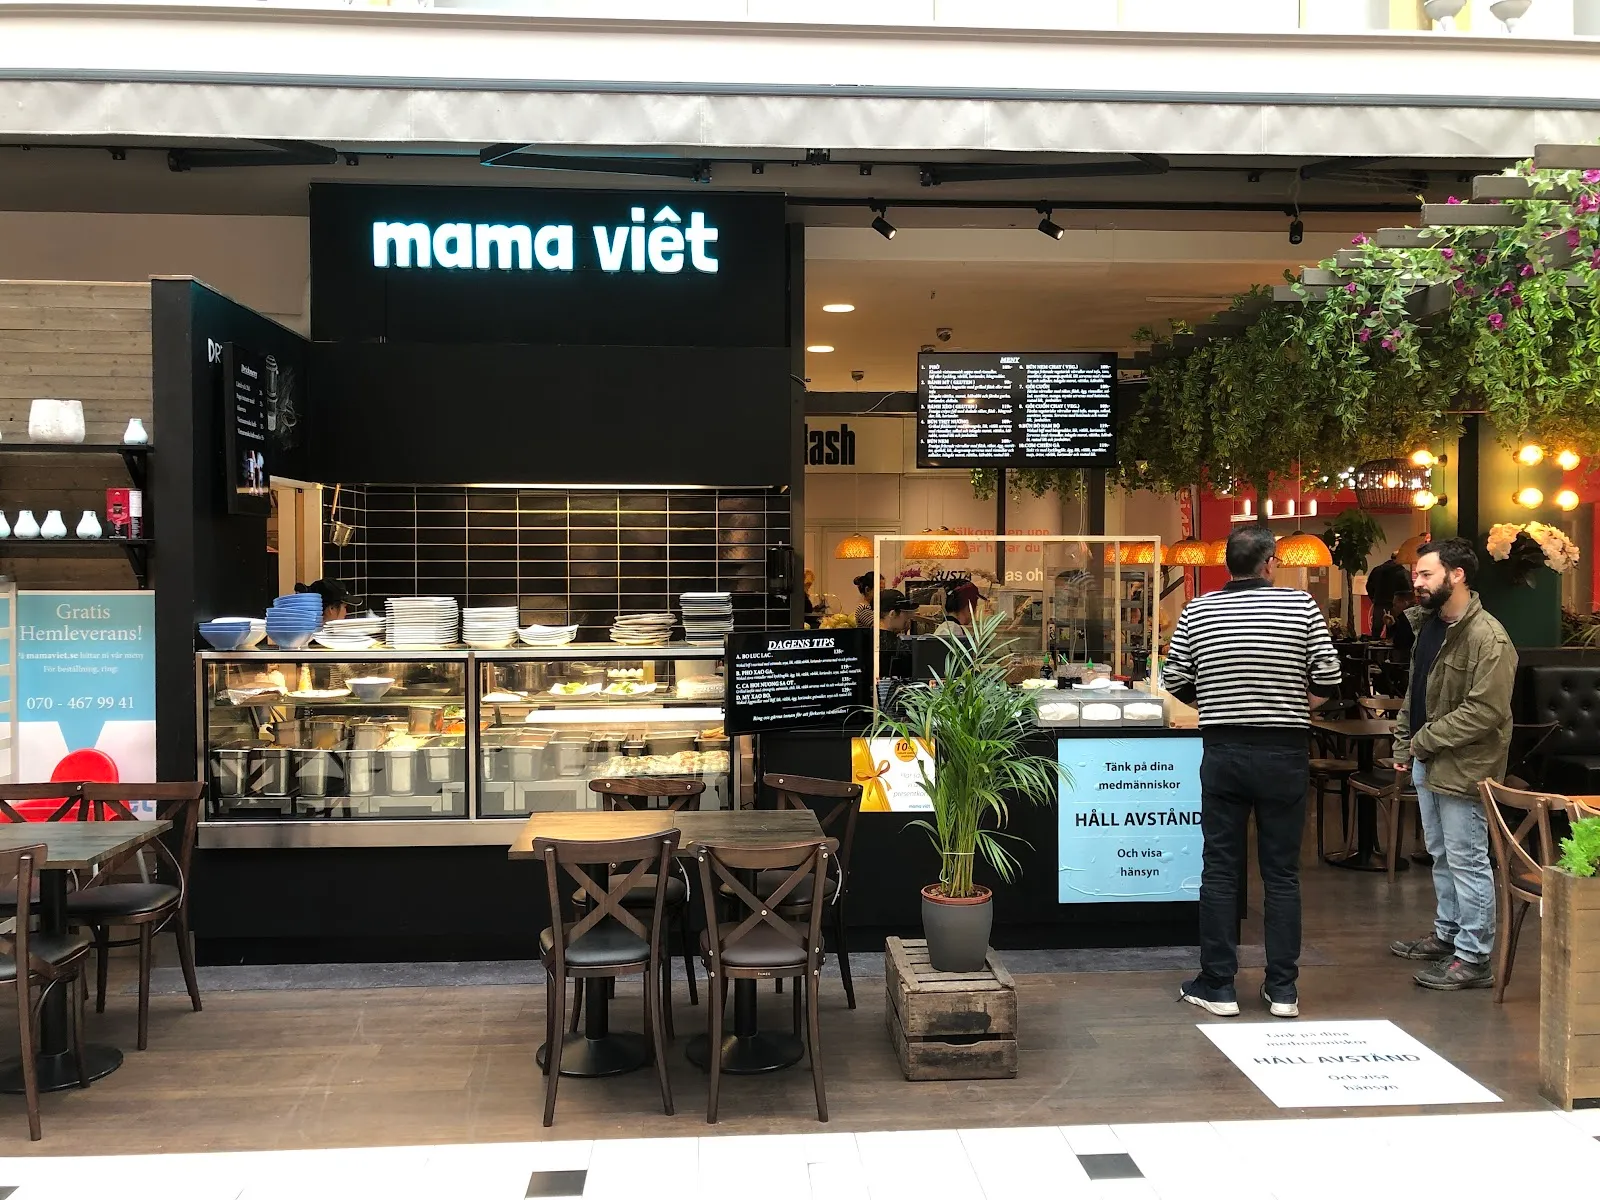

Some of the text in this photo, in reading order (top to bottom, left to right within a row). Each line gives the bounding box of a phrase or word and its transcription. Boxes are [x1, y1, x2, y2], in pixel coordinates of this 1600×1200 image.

[373, 205, 719, 274] mama viêt
[968, 543, 982, 553] är
[1025, 543, 1040, 553] du
[1004, 567, 1044, 581] as oh
[56, 603, 111, 619] Gratis
[19, 625, 143, 641] Hemleverans!
[767, 637, 835, 651] DAGENS TIPS
[26, 652, 79, 660] mamaviet.se
[80, 651, 101, 659] hittar
[110, 651, 123, 659] vår
[124, 653, 144, 661] meny
[43, 664, 58, 673] För
[26, 697, 54, 710] 070
[67, 697, 93, 710] 467
[97, 697, 115, 709] 99
[118, 696, 134, 709] 41
[1105, 760, 1174, 774] Tänk på dina
[1098, 779, 1181, 790] medmänniskor
[1075, 807, 1203, 827] HÅLL AVSTÅND
[1117, 848, 1162, 858] Och visa
[1120, 866, 1160, 878] hänsyn
[1318, 1052, 1421, 1063] AVSTÅND
[1328, 1072, 1390, 1081] Och visa
[1342, 1082, 1399, 1092] hänsyn
